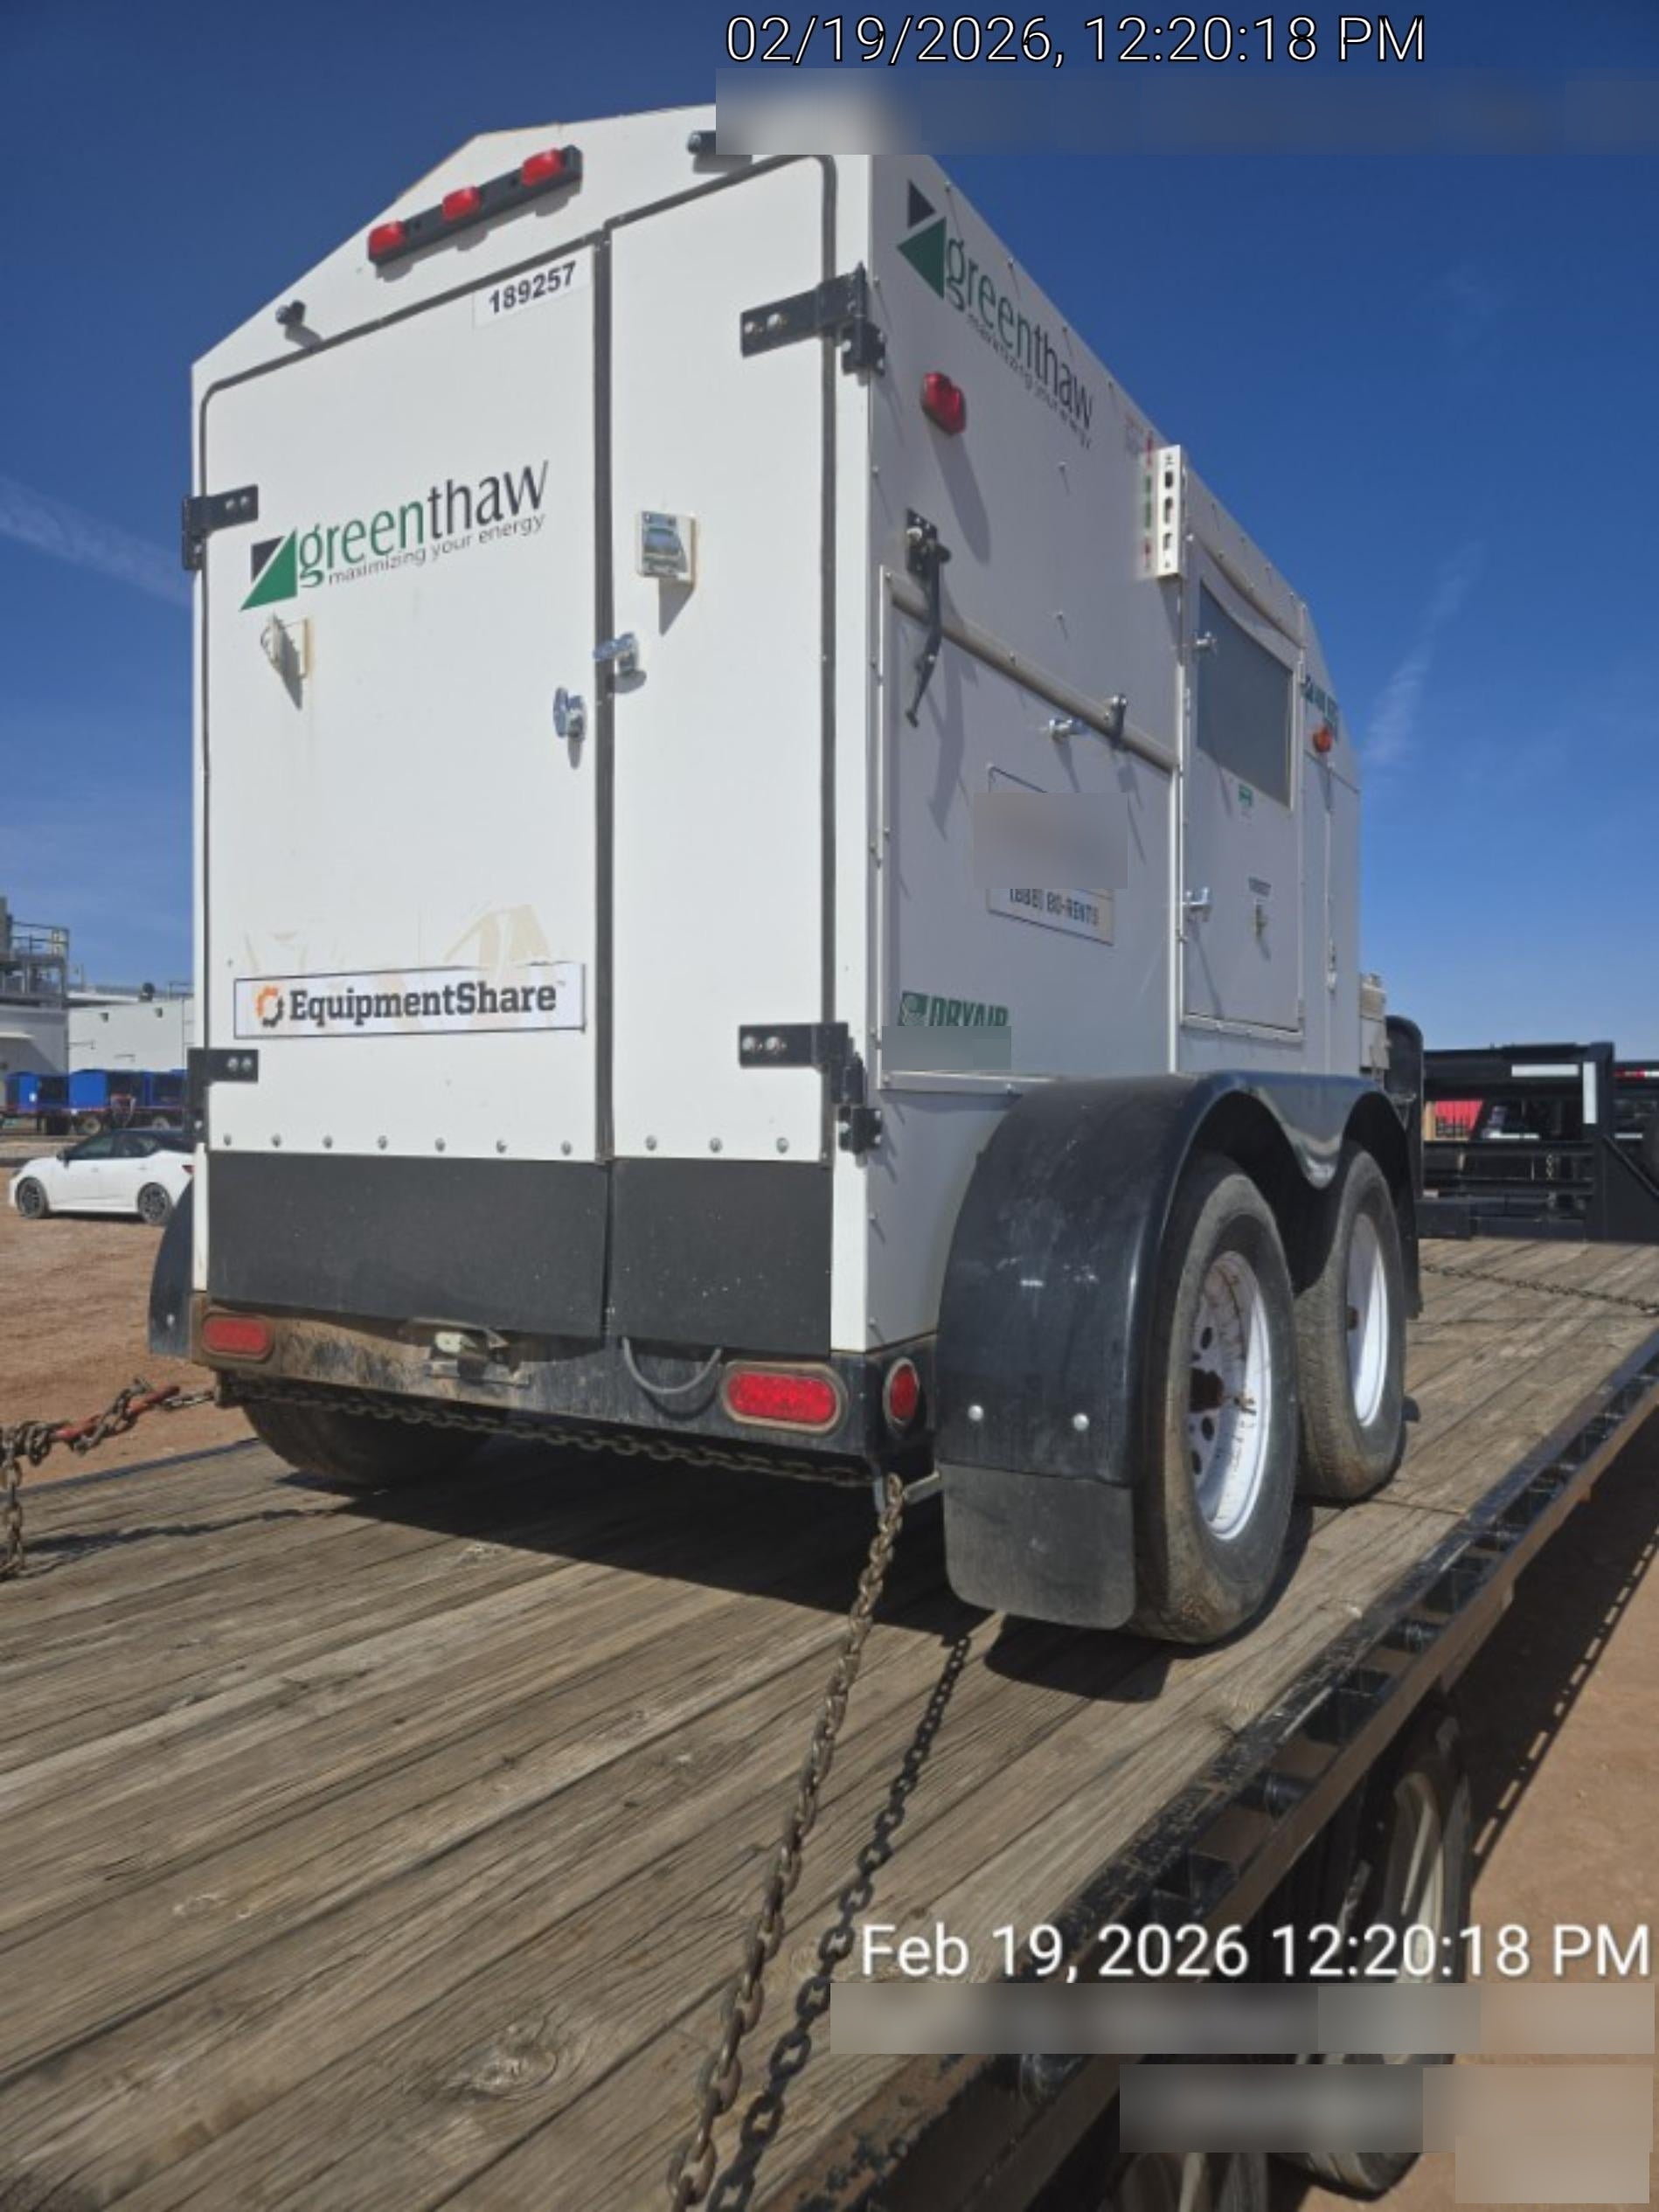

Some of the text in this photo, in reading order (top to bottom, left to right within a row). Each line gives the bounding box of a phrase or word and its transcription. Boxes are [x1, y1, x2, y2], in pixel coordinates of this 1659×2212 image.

[489, 260, 576, 314] 189257
[947, 238, 1093, 429] greenthaw
[299, 460, 549, 588] greenthaw
[329, 513, 545, 585] maximizing your energy
[289, 981, 556, 1027] EquipmentShare
